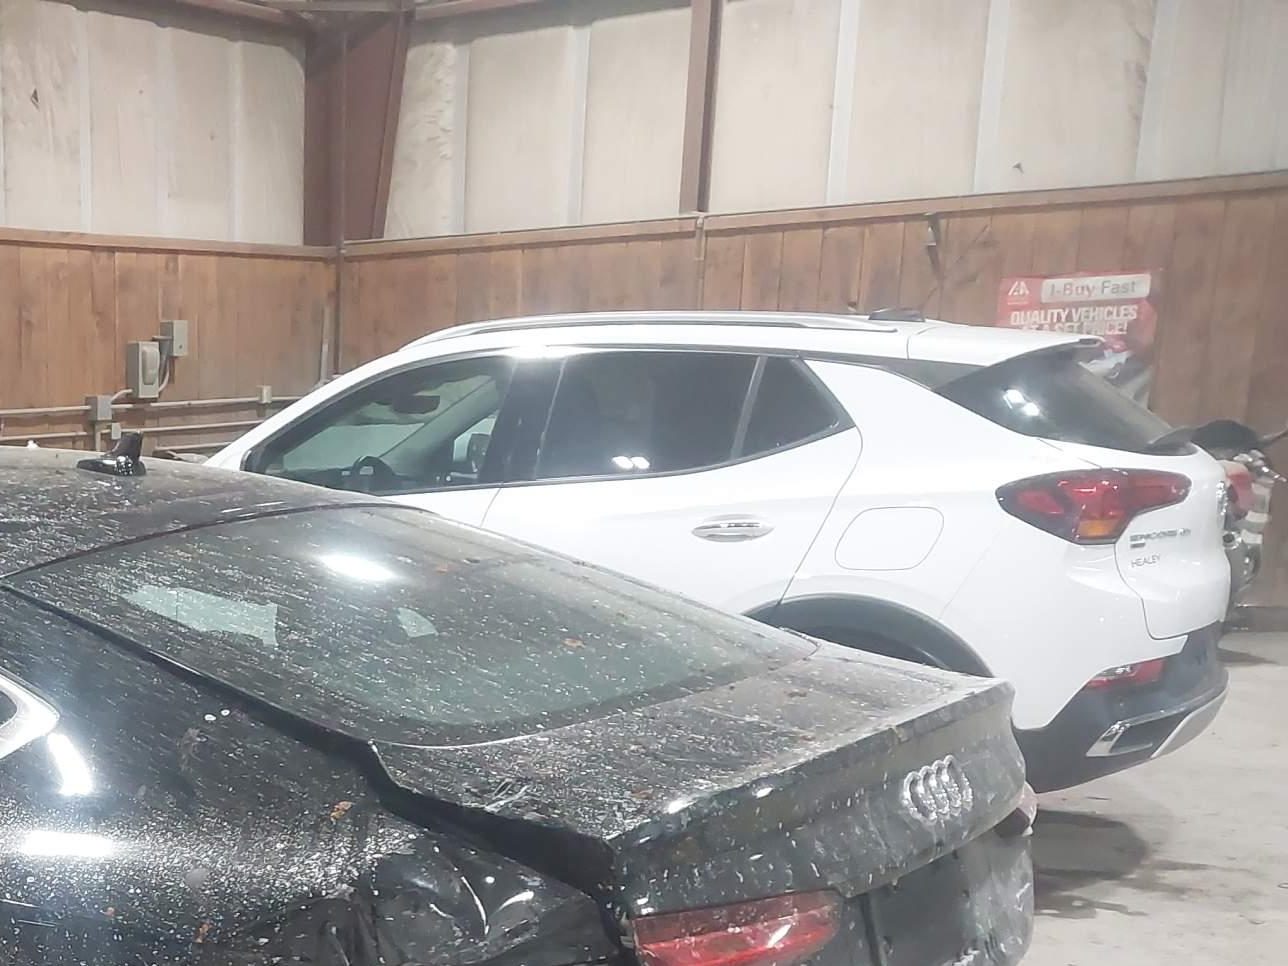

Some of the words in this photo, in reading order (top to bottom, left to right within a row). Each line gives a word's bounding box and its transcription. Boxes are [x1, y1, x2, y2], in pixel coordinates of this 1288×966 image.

[1101, 280, 1136, 294] Fast
[1011, 309, 1069, 325] QUALITY
[1071, 304, 1138, 321] VEHICLES
